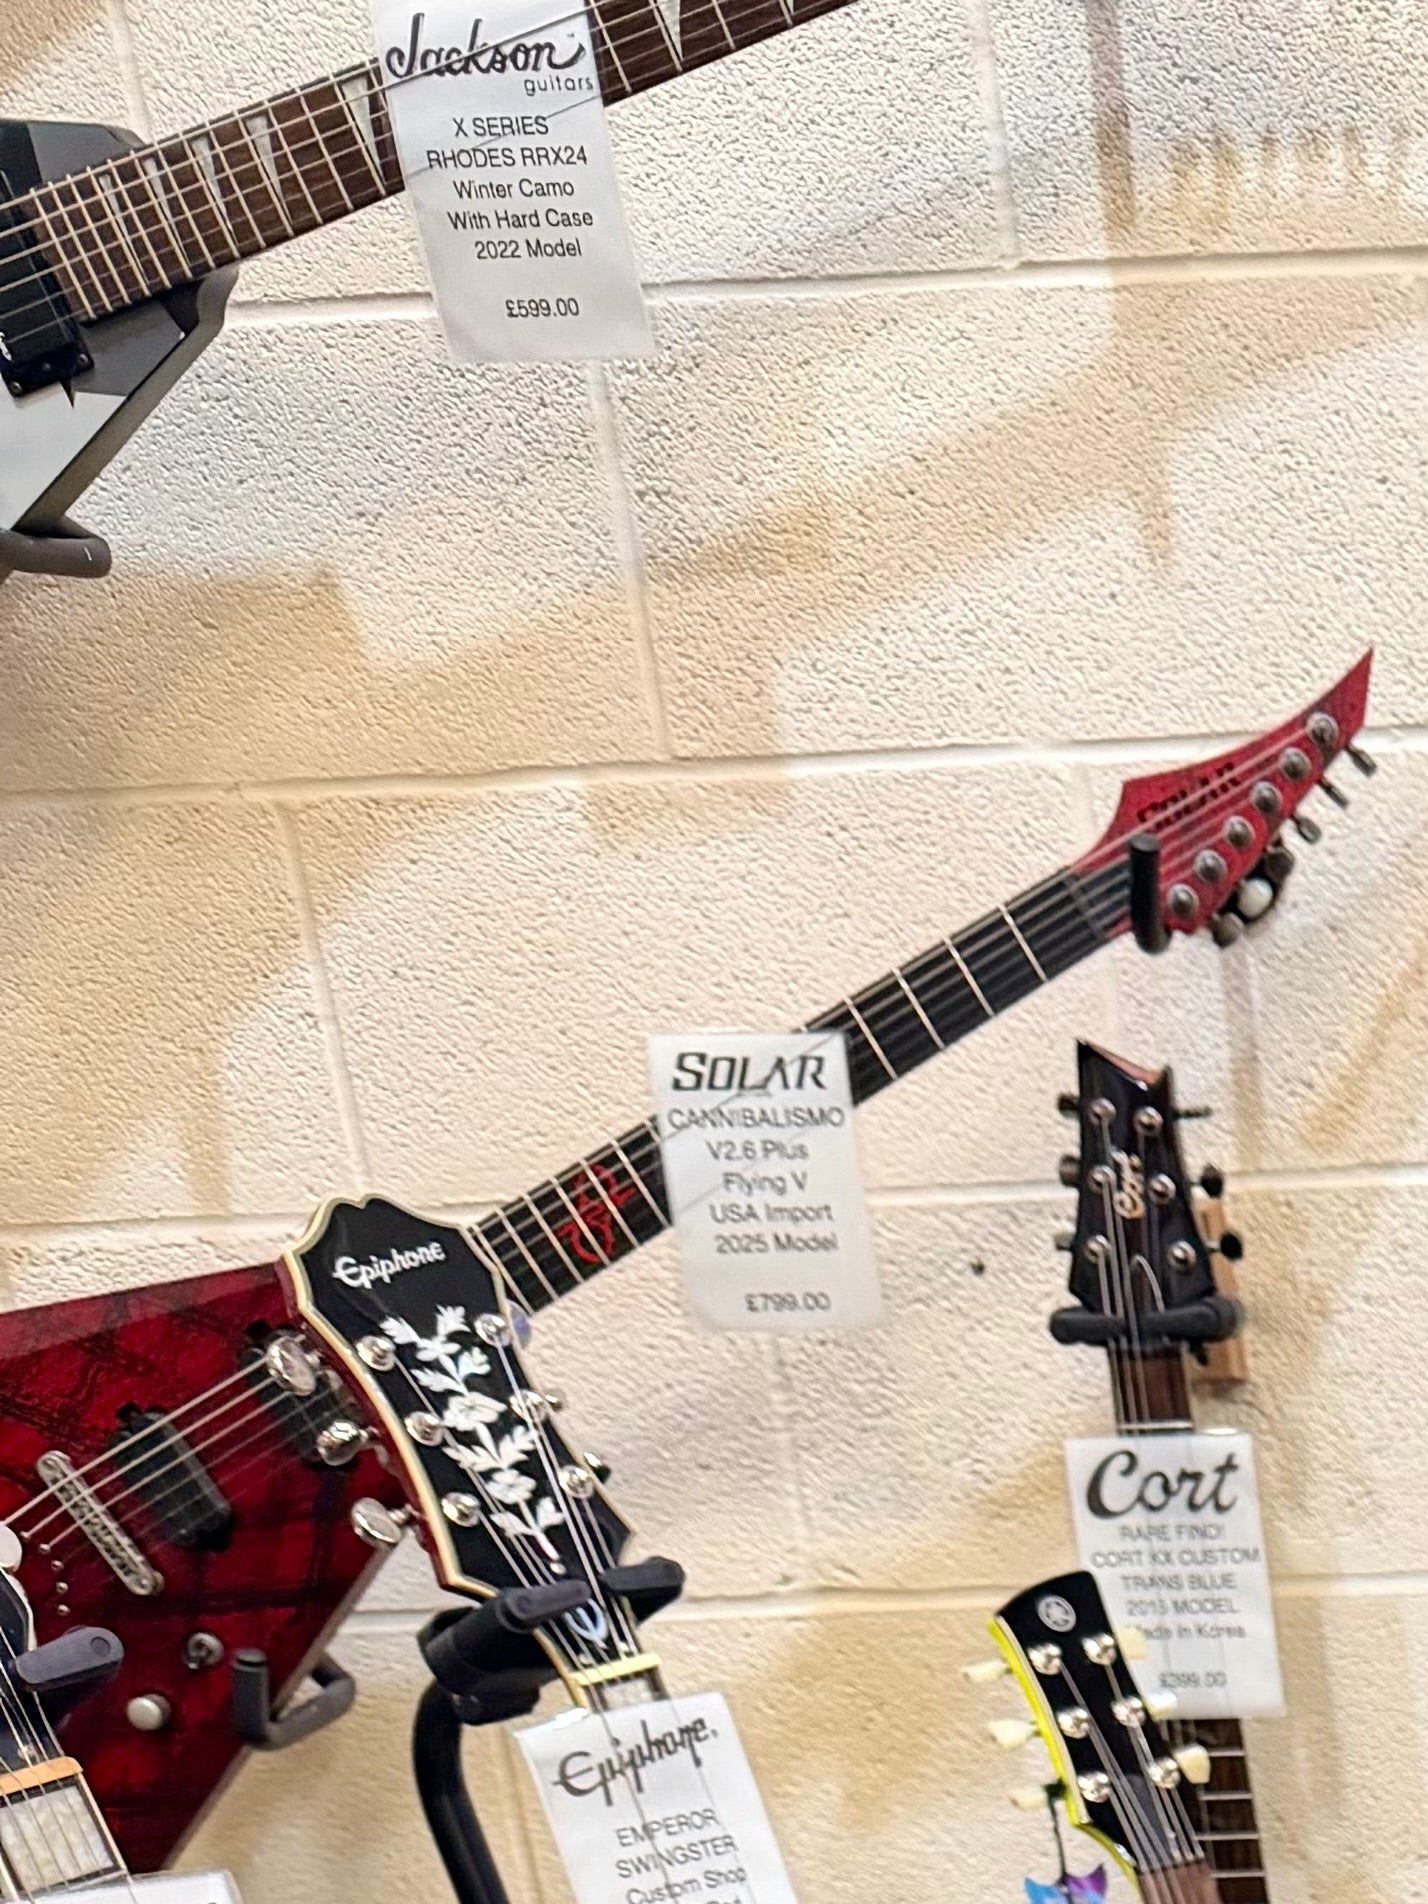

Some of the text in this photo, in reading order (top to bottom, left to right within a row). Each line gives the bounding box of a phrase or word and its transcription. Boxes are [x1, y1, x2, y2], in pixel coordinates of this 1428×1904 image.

[386, 12, 587, 78] Jackson
[524, 76, 593, 96] guitars
[454, 116, 549, 137] X SERIES
[427, 146, 587, 169] RHODES RRX24
[453, 178, 574, 199] Winter Camo
[447, 209, 593, 230] With Hard Case
[475, 239, 582, 259] 2022 Model
[505, 298, 579, 318] £599.00
[672, 1052, 826, 1091] SOLAR
[668, 1107, 844, 1130] CANNIBALISMO
[706, 1140, 809, 1160] V2.6 Plus
[723, 1172, 807, 1195] Flying V
[710, 1204, 832, 1225] USA Import
[774, 1233, 838, 1252] Model
[333, 1242, 446, 1289] Epiphone
[1086, 1450, 1238, 1520] Cort
[1178, 1548, 1260, 1565] CUSTOM
[616, 1808, 719, 1847] EMPEROR
[615, 1835, 739, 1878] SWINGSTER
[705, 1866, 748, 1891] Shop
